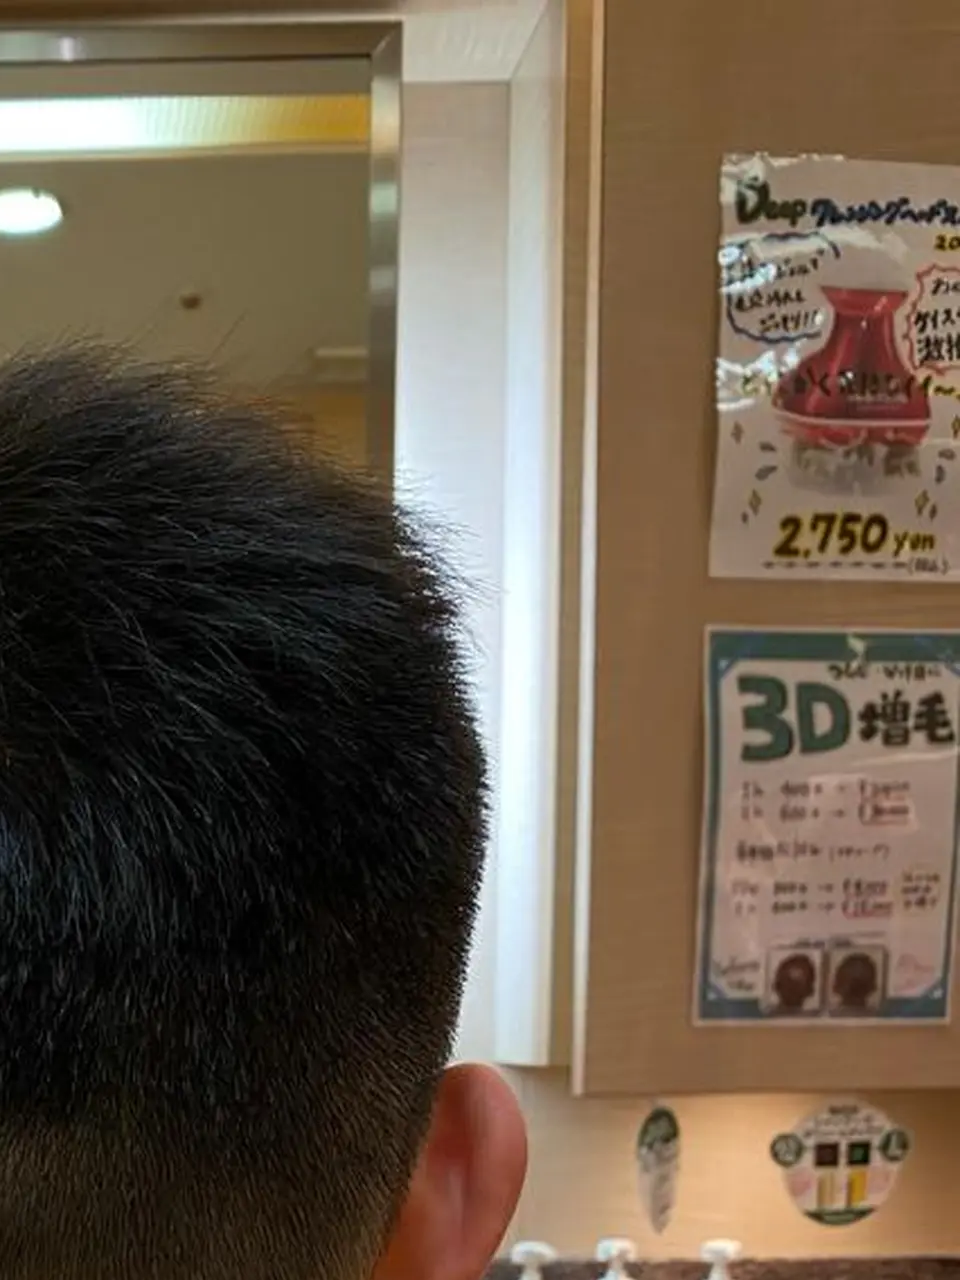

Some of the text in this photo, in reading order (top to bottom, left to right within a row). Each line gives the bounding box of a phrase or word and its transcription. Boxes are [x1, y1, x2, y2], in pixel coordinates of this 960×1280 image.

[773, 512, 936, 560] 2,750 yen
[736, 672, 956, 764] 3D増毛
